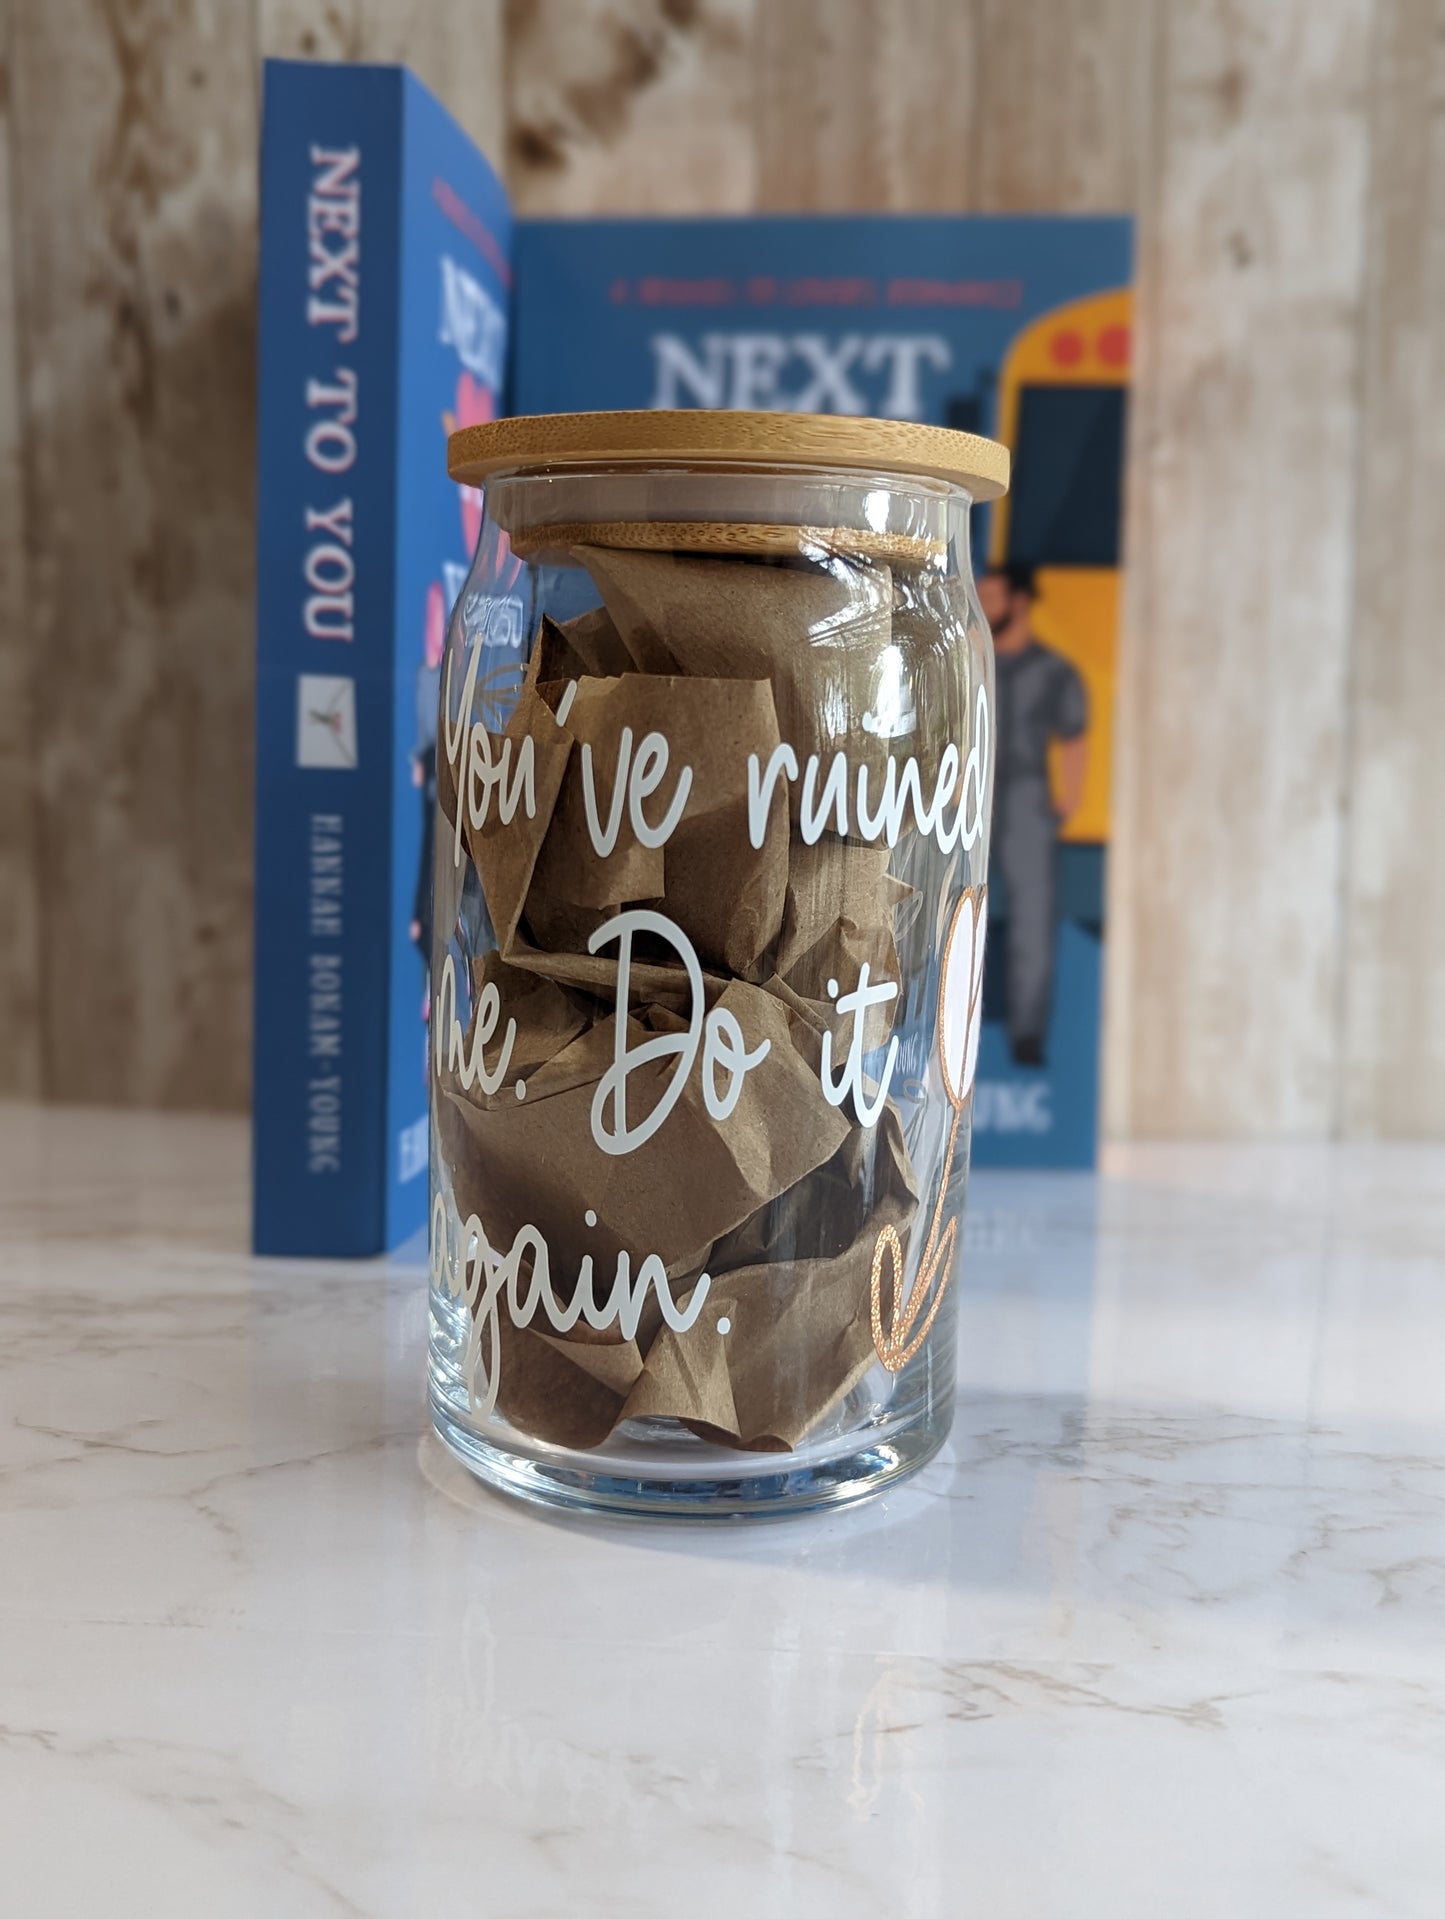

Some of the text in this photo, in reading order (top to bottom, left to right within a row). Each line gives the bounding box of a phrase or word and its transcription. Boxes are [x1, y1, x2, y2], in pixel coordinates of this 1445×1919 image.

[303, 144, 361, 642] NEXT TO YOU
[650, 331, 952, 418] NEXT
[445, 632, 989, 868] You've ruined
[310, 813, 344, 938] HANNAH
[587, 909, 772, 1156] Do
[820, 962, 899, 1129] it
[432, 1191, 731, 1419] again.
